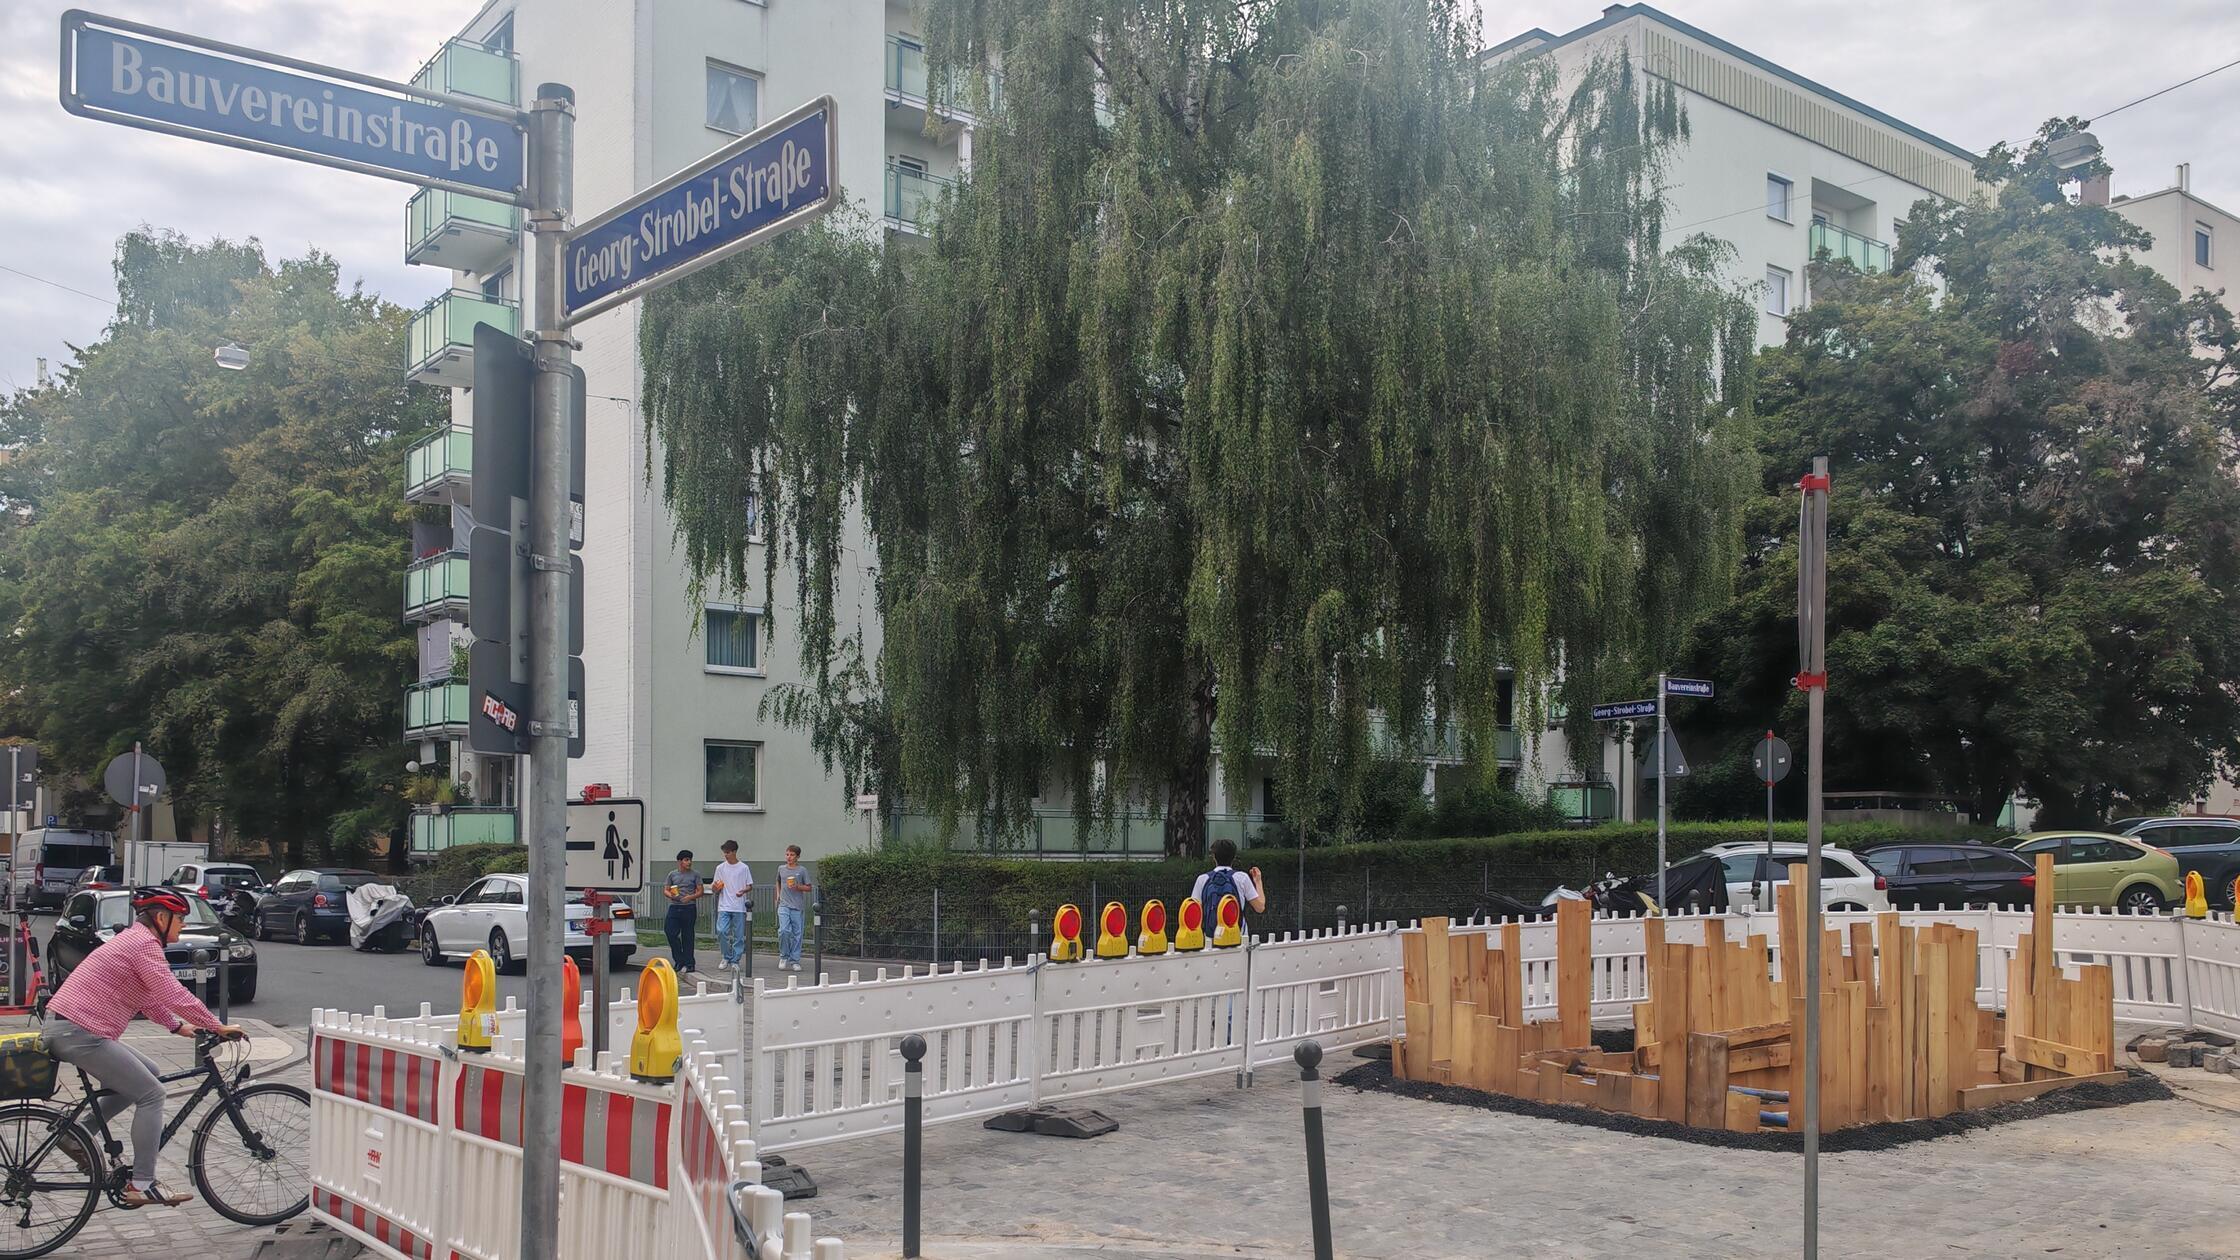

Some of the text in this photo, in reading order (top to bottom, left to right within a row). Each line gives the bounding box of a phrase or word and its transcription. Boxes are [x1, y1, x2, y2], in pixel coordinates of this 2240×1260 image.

[111, 40, 499, 173] Bauvereinstraße
[575, 139, 811, 294] Georg-Strobel-Straße
[1593, 702, 1656, 718] Georg-Strobel-Straße
[1667, 680, 1710, 694] Bauvereinstraße
